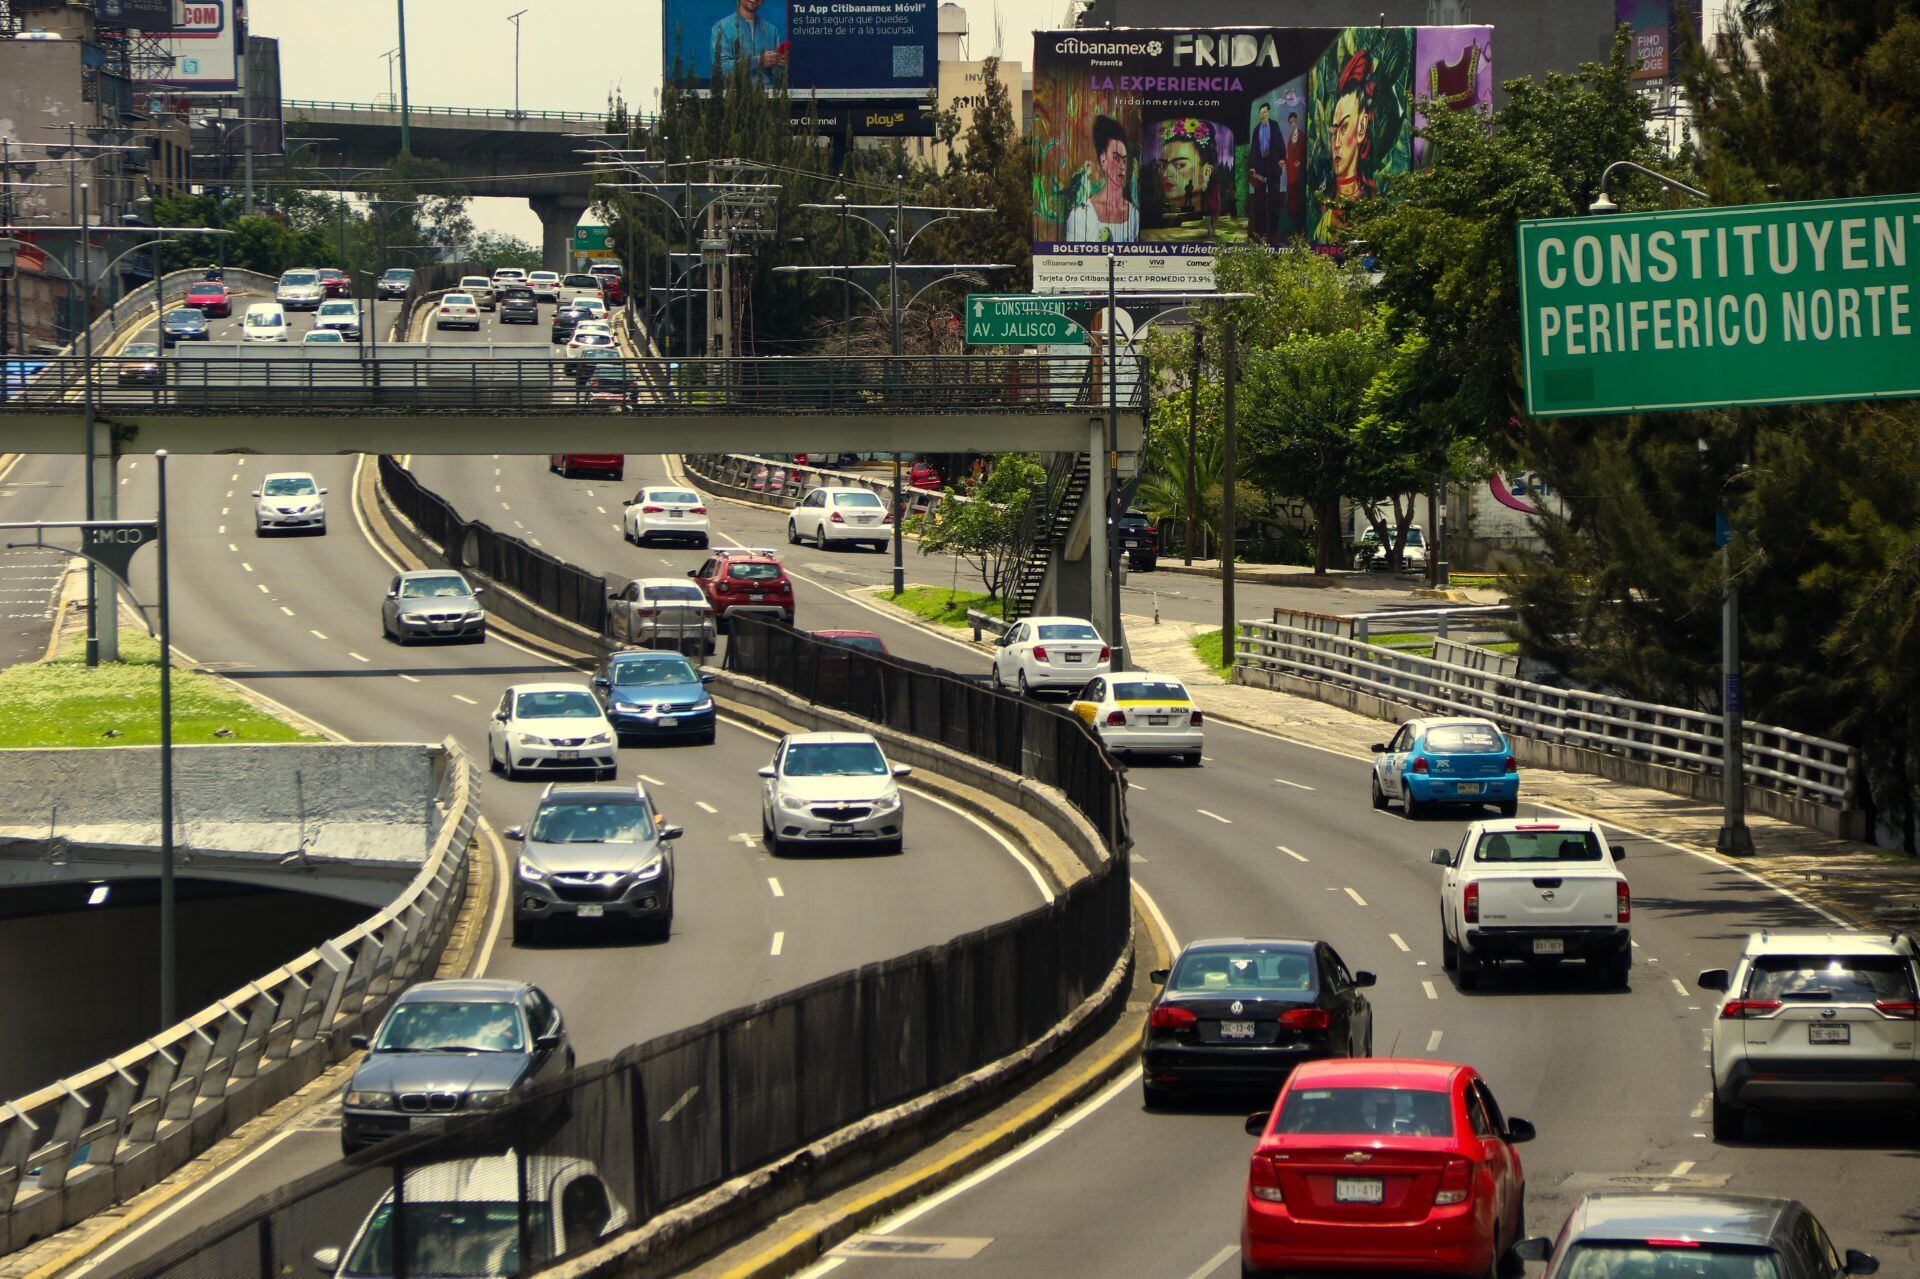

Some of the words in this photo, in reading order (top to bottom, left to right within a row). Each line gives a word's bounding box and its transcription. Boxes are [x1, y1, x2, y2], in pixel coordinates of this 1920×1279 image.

[793, 4, 806, 13] Tu
[808, 4, 828, 14] App
[831, 4, 892, 13] Citibanamex
[184, 7, 216, 24] COM
[806, 16, 821, 24] tan
[823, 17, 854, 26] segura
[856, 17, 873, 26] que
[875, 15, 909, 26] puedes
[793, 26, 833, 35] olvidarte
[835, 26, 847, 35] de
[849, 26, 856, 35] ir
[866, 26, 874, 34] la
[1638, 35, 1660, 47] FIND
[1055, 37, 1146, 55] citibanamex
[1173, 34, 1280, 68] FRIDA
[1638, 46, 1664, 58] YOUR
[1091, 59, 1123, 67] Presenta
[1640, 59, 1663, 71] DGE
[1090, 75, 1114, 91] LA
[1120, 76, 1243, 92] EXPERIENCIA
[1114, 96, 1220, 106] fridainmersiva.com
[800, 116, 837, 125] Cnnel
[866, 113, 895, 127] play
[1053, 244, 1099, 253] BOLETOS
[1102, 244, 1114, 254] EN
[1116, 244, 1167, 254] TAQUILLA
[1170, 245, 1178, 254] Y
[1537, 214, 1920, 289] CONSTITUYEN
[1043, 259, 1077, 267] citibanamex
[1039, 275, 1063, 283] Tarjeta
[1128, 275, 1142, 283] CAT
[1145, 275, 1185, 283] PROMEDIO
[1540, 293, 1767, 356] PERIFERICO
[1782, 284, 1912, 342] NORTE
[973, 323, 994, 337] AV.
[1001, 322, 1056, 337] JALISCO
